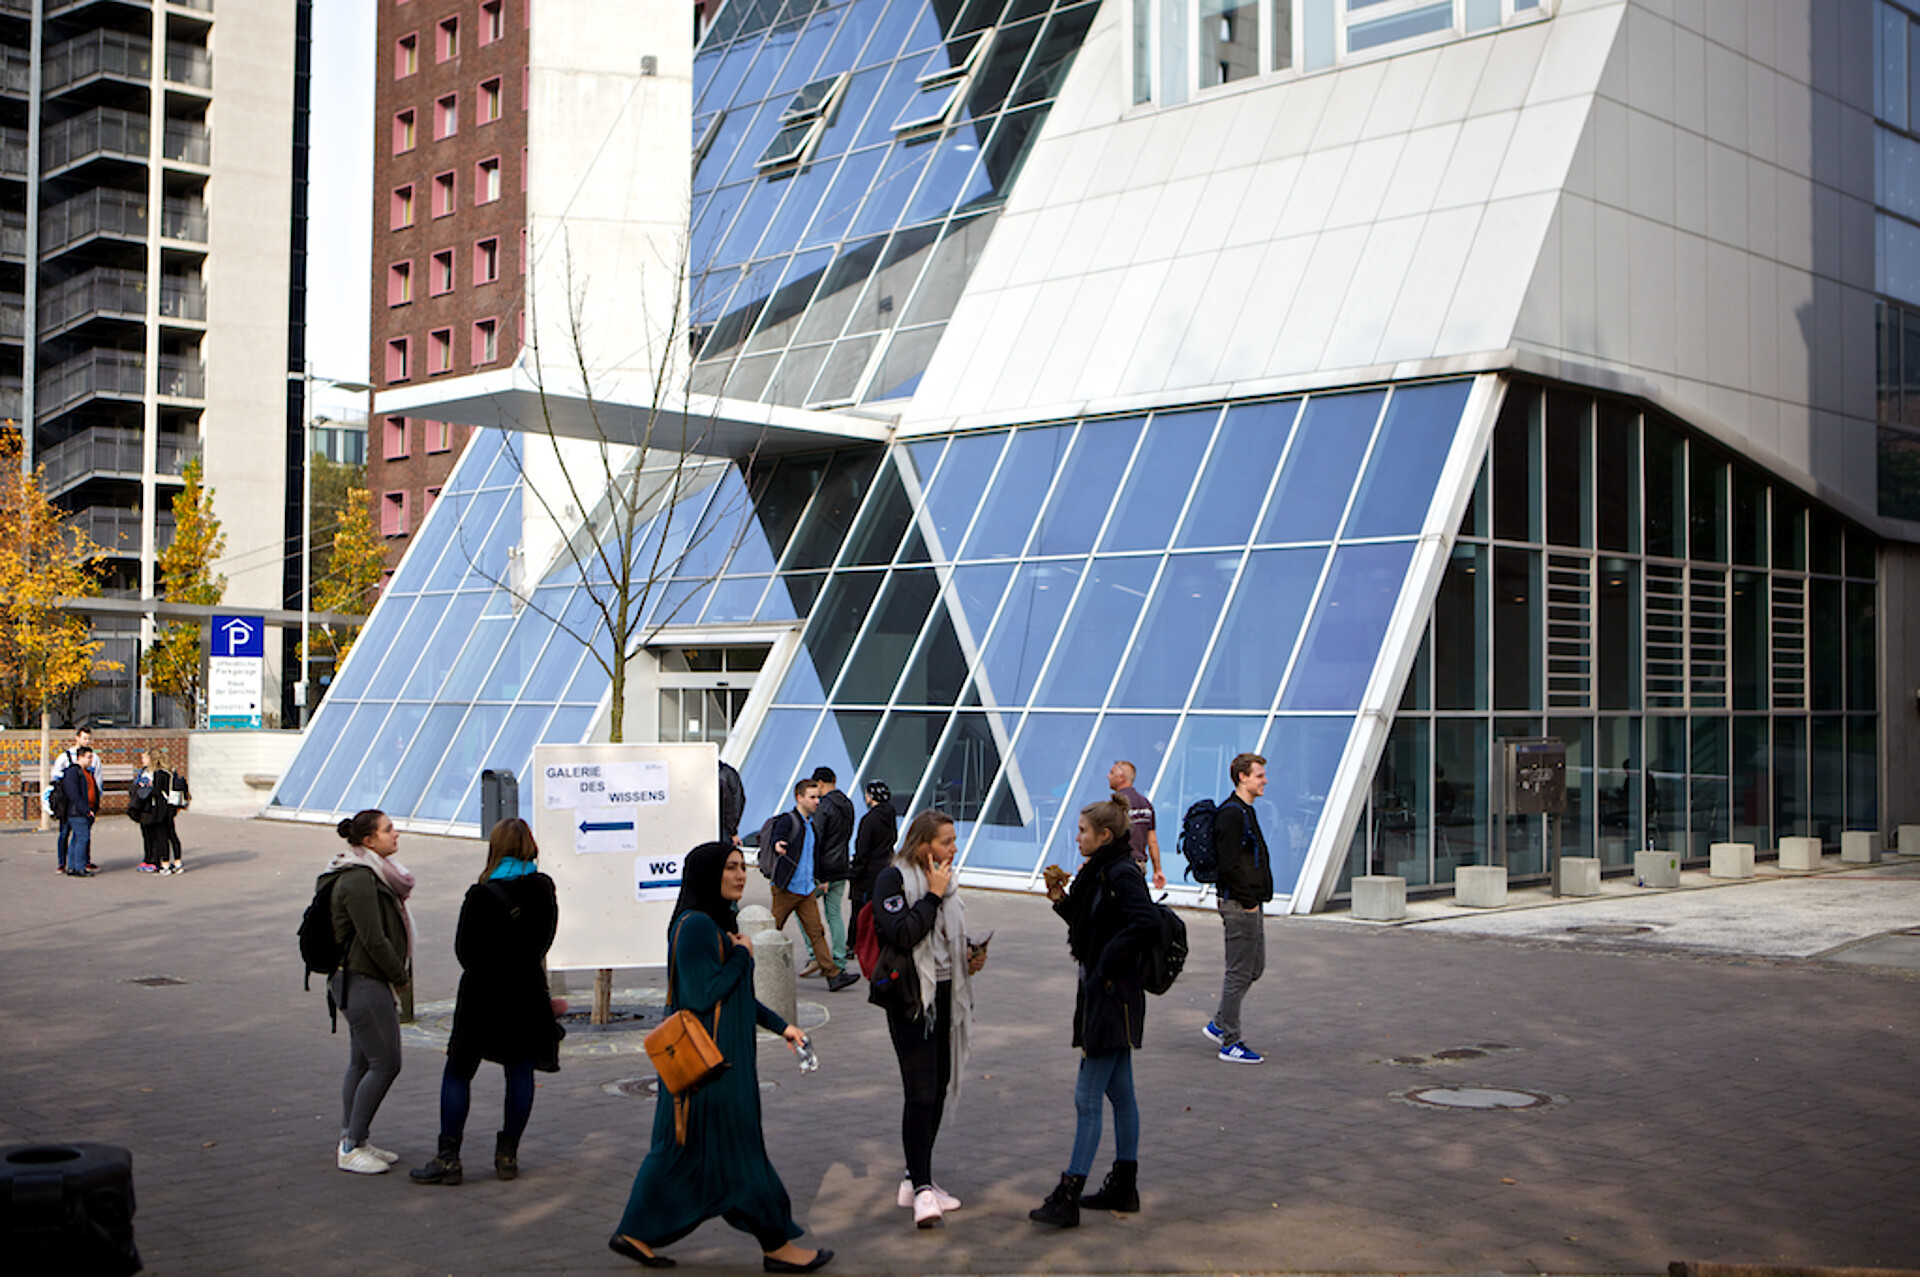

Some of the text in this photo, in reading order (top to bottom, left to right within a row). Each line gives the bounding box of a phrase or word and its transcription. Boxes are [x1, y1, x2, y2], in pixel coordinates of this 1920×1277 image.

[229, 626, 250, 656] P
[215, 668, 257, 677] Parkgarage
[546, 766, 602, 778] GALERIE
[579, 782, 605, 793] DES
[608, 791, 666, 803] WISSENS
[649, 861, 678, 875] WC
